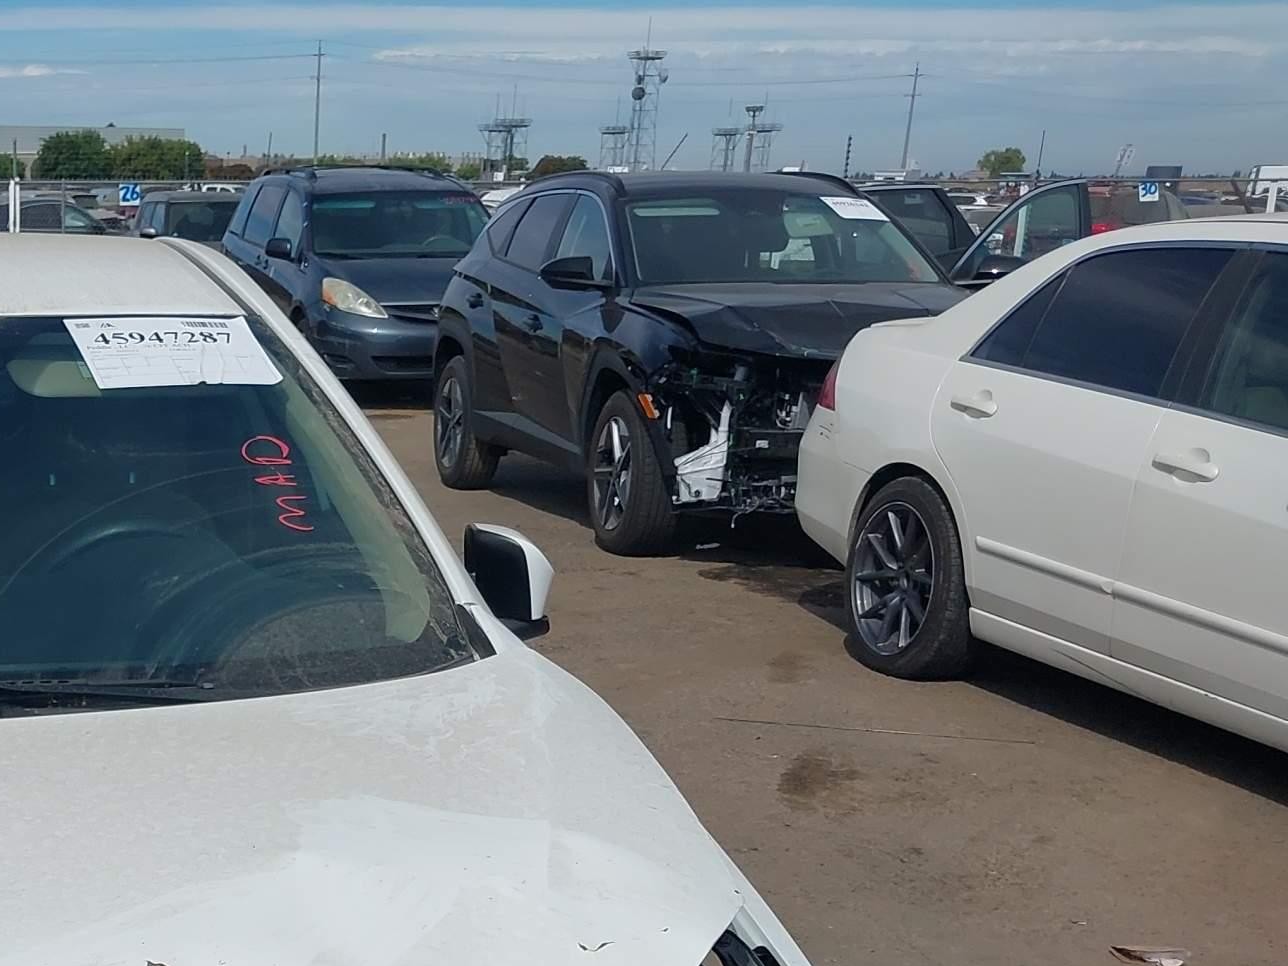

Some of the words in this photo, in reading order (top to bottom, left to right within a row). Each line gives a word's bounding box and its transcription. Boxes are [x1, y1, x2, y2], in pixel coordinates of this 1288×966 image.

[119, 183, 139, 202] 26
[1140, 181, 1158, 198] 30
[94, 331, 231, 345] 45947287
